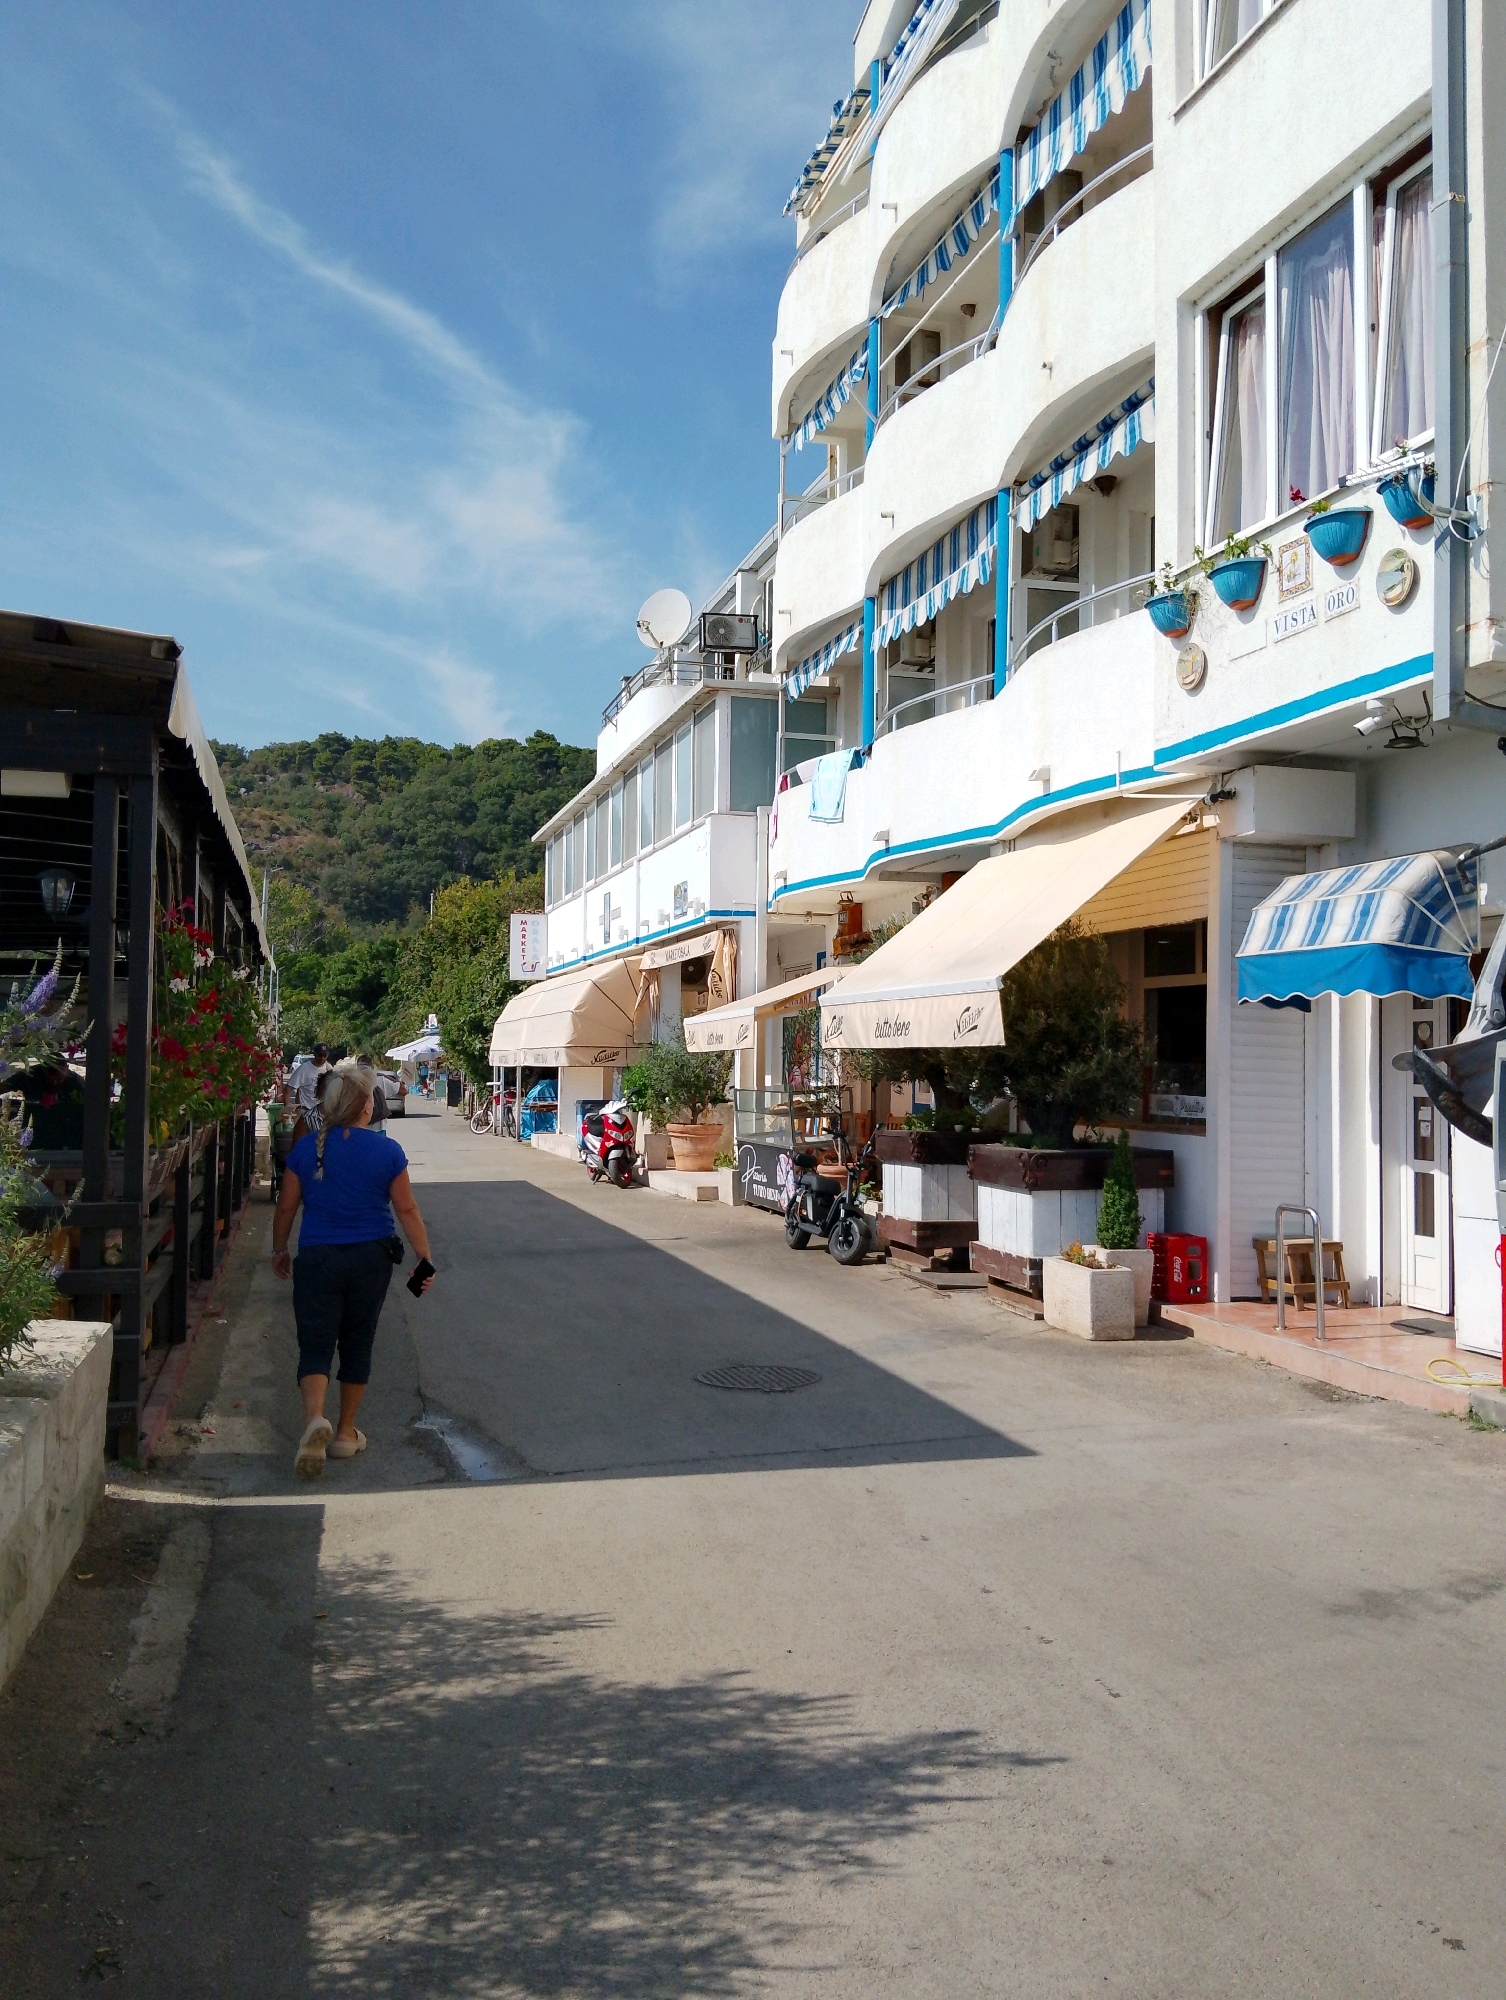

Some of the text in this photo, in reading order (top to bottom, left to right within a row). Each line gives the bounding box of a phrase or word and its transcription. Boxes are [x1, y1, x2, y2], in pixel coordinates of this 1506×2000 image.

[1273, 586, 1356, 635] VISTA ORO
[519, 919, 528, 961] MARKET
[531, 920, 540, 961] OBALA
[874, 1012, 911, 1039] tutto bene
